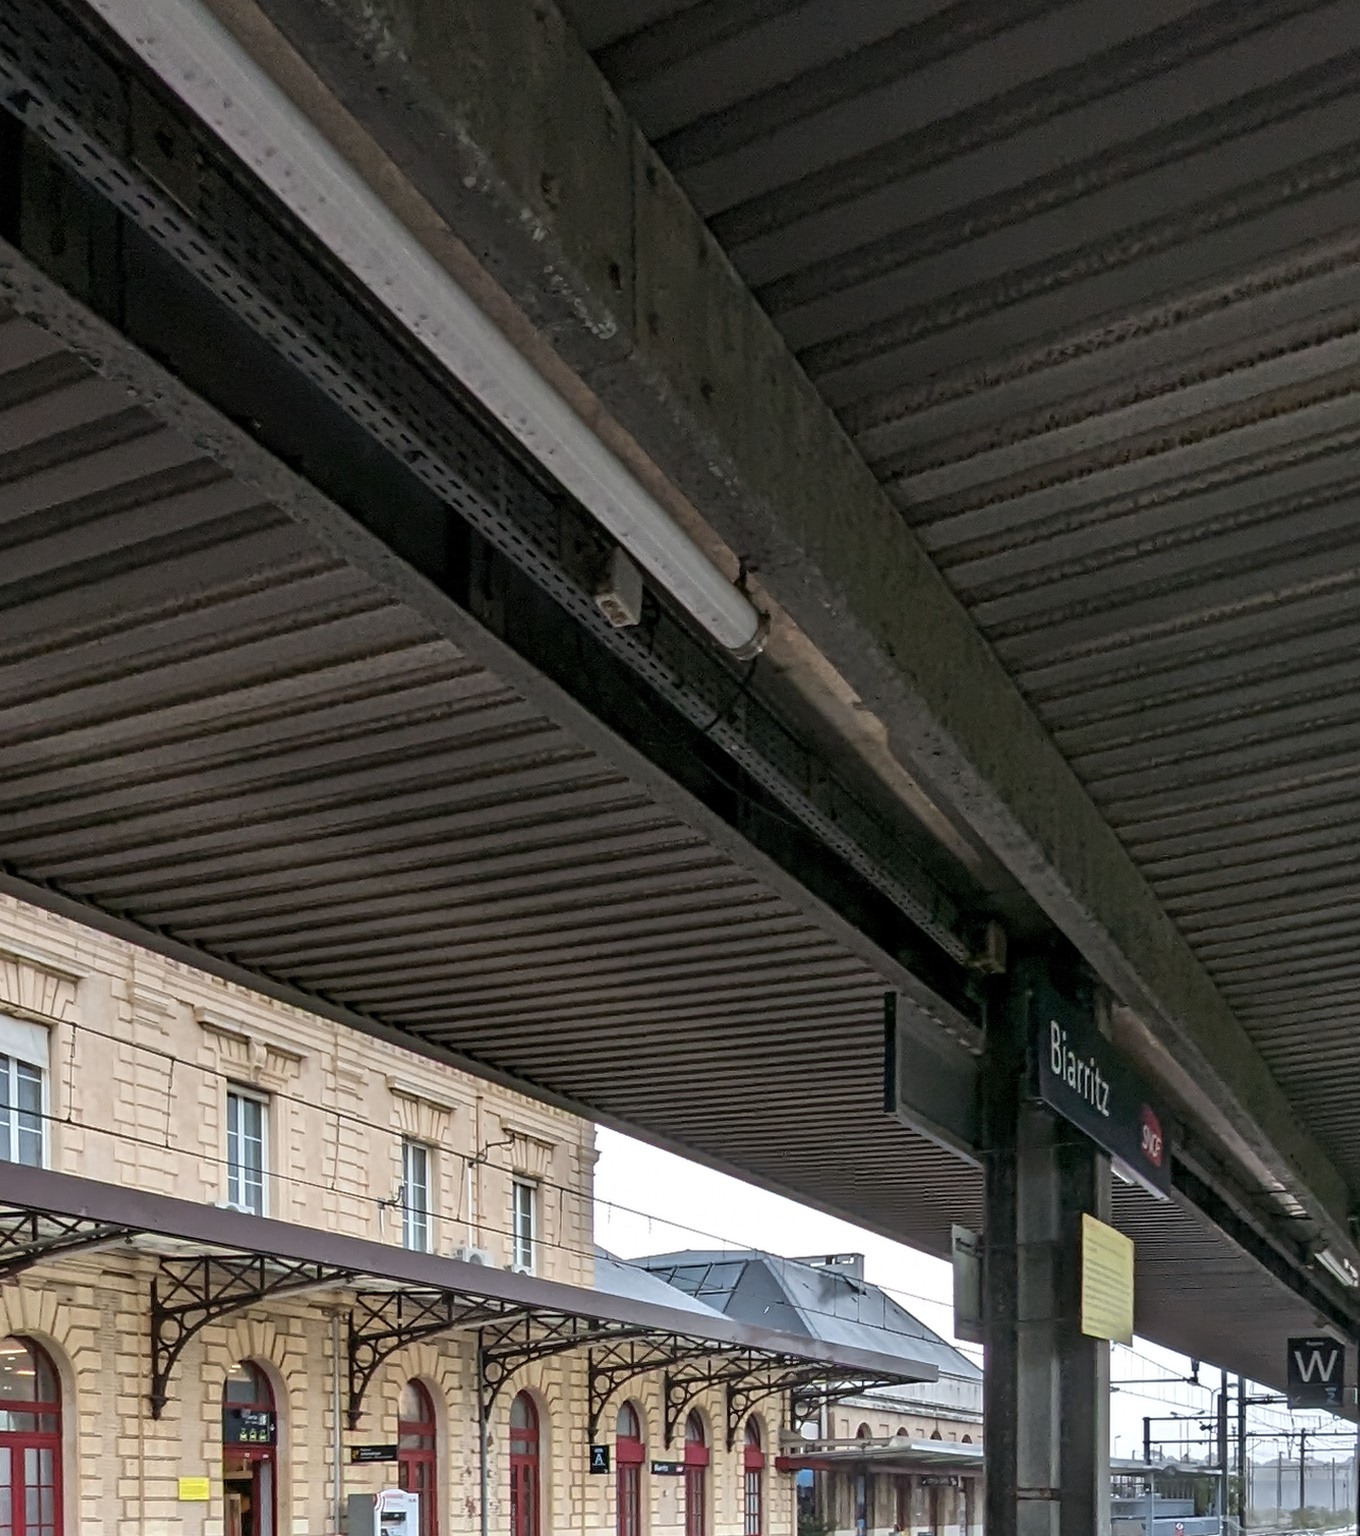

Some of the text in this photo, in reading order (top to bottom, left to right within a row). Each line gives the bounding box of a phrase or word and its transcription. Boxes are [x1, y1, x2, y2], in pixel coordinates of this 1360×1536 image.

[1050, 1019, 1110, 1117] Biarritz
[1293, 1349, 1339, 1383] W
[594, 1453, 604, 1465] A
